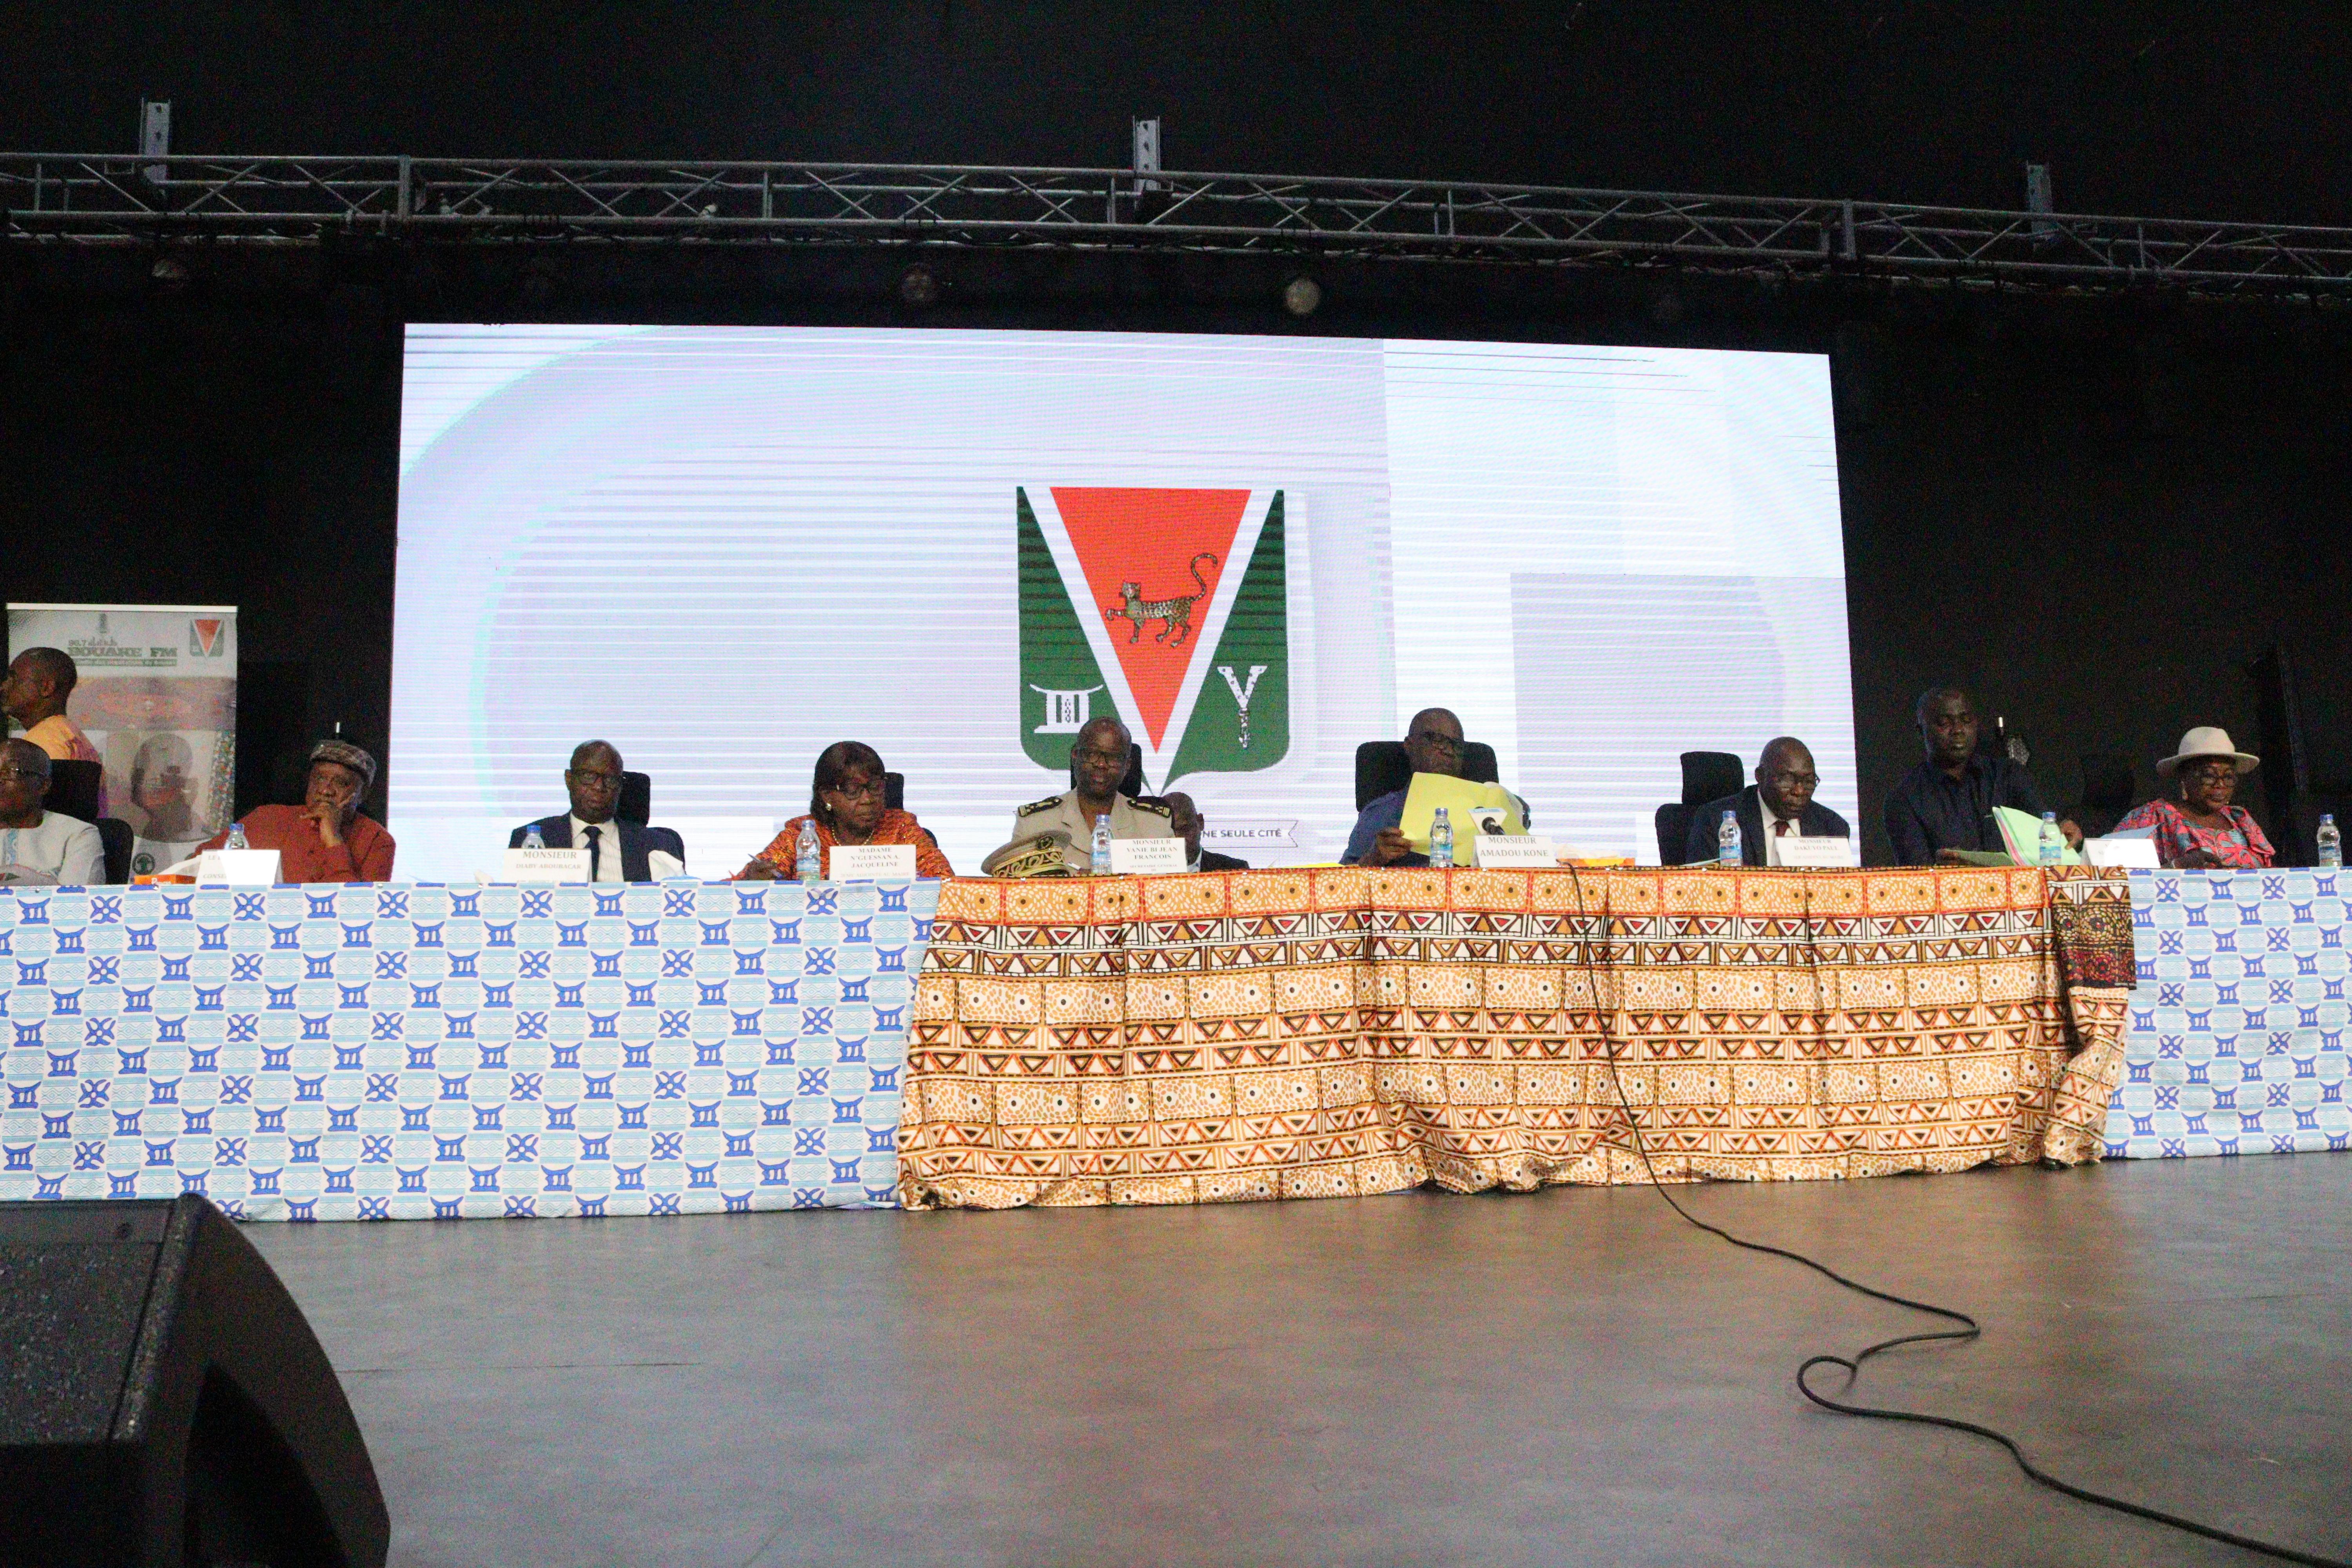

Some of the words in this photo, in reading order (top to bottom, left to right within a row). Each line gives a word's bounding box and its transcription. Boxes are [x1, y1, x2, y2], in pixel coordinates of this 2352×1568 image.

[150, 648, 177, 657] FM
[1220, 829, 1255, 838] SEULE
[1258, 828, 1281, 837] CITÉ
